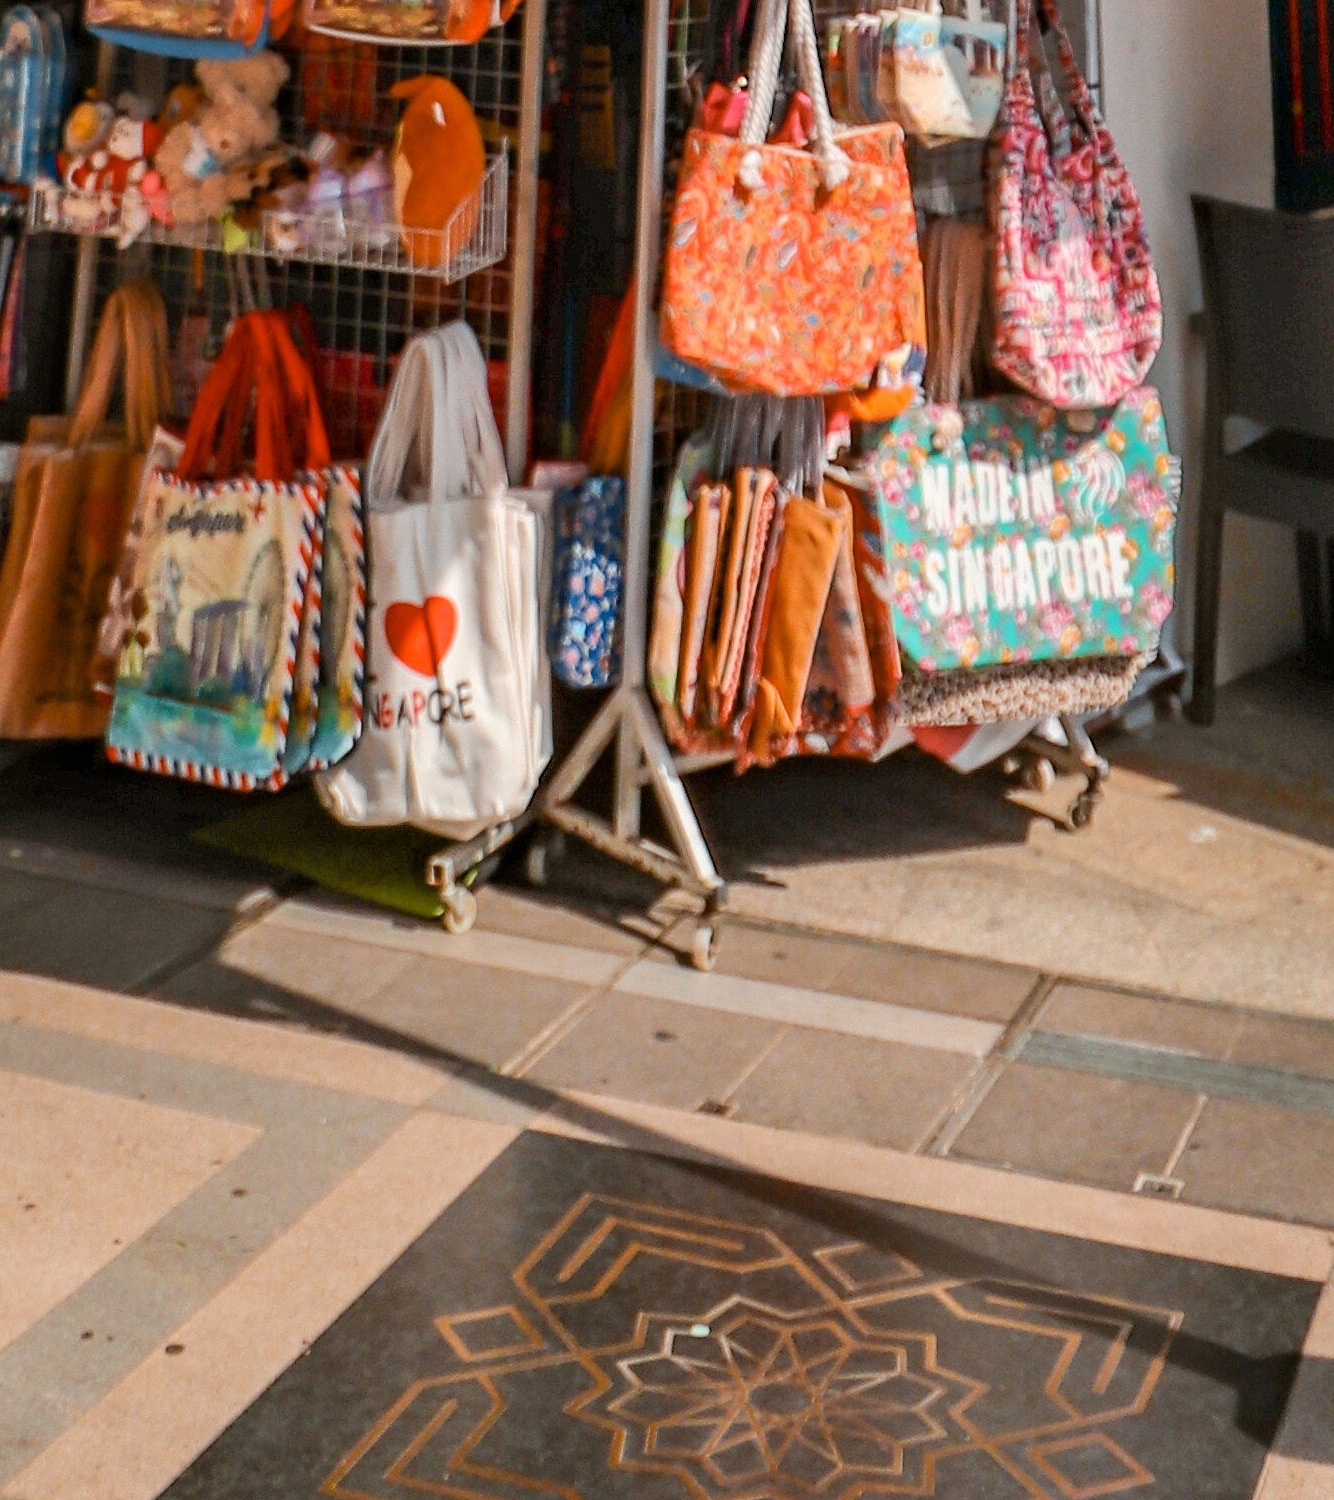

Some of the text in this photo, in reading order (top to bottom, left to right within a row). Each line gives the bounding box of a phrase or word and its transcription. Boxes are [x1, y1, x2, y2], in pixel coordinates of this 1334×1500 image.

[923, 459, 1056, 531] MADE IN
[925, 531, 1134, 617] SINGAPORE
[369, 678, 476, 730] NGAPORE
